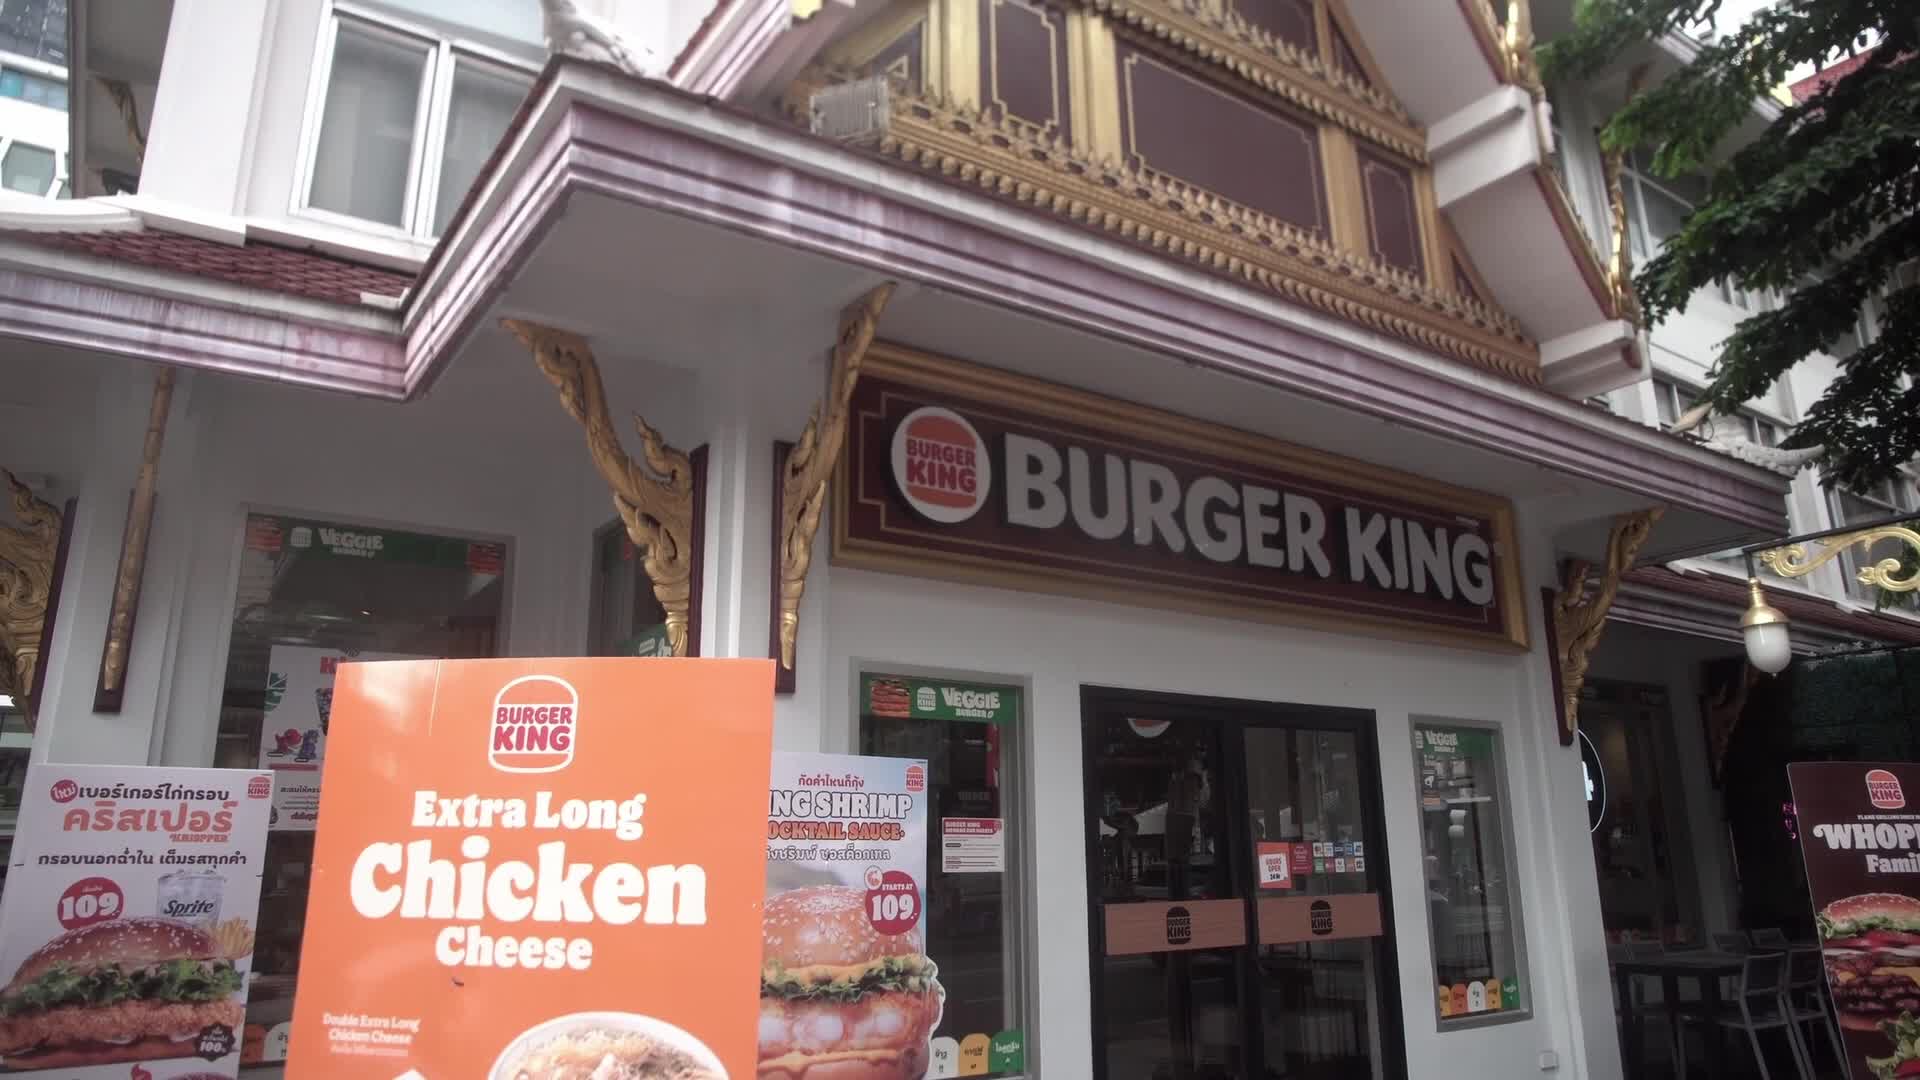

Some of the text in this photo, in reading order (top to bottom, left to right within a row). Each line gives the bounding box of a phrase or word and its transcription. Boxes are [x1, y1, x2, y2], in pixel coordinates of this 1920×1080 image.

[906, 439, 976, 468] BURGER
[907, 458, 977, 493] KING
[1004, 431, 1495, 605] BURGER KING
[941, 687, 1001, 709] VEGGIE
[496, 706, 572, 725] BURGER
[493, 725, 571, 751] KING
[79, 783, 230, 801] เบอร์เกอร์ไก่กรอบ
[906, 779, 924, 787] KING
[814, 790, 913, 820] SHRIMP
[1871, 789, 1902, 801] KING
[63, 800, 239, 832] คริสเปอร์
[411, 790, 647, 841] Extra Long
[768, 820, 846, 841] OCKTAIL
[38, 847, 247, 869] กรอบนอกฉ่ำใน เต็มรสทุกคำ
[350, 835, 707, 926] Chicken
[163, 899, 215, 918] Sprite
[1167, 918, 1191, 927] BURGER
[1167, 926, 1191, 938] KING
[1311, 918, 1333, 930] KING
[435, 925, 593, 970] Cheese
[323, 1013, 420, 1033] Double Extra Long
[328, 1028, 413, 1044] Chicken Cheese
